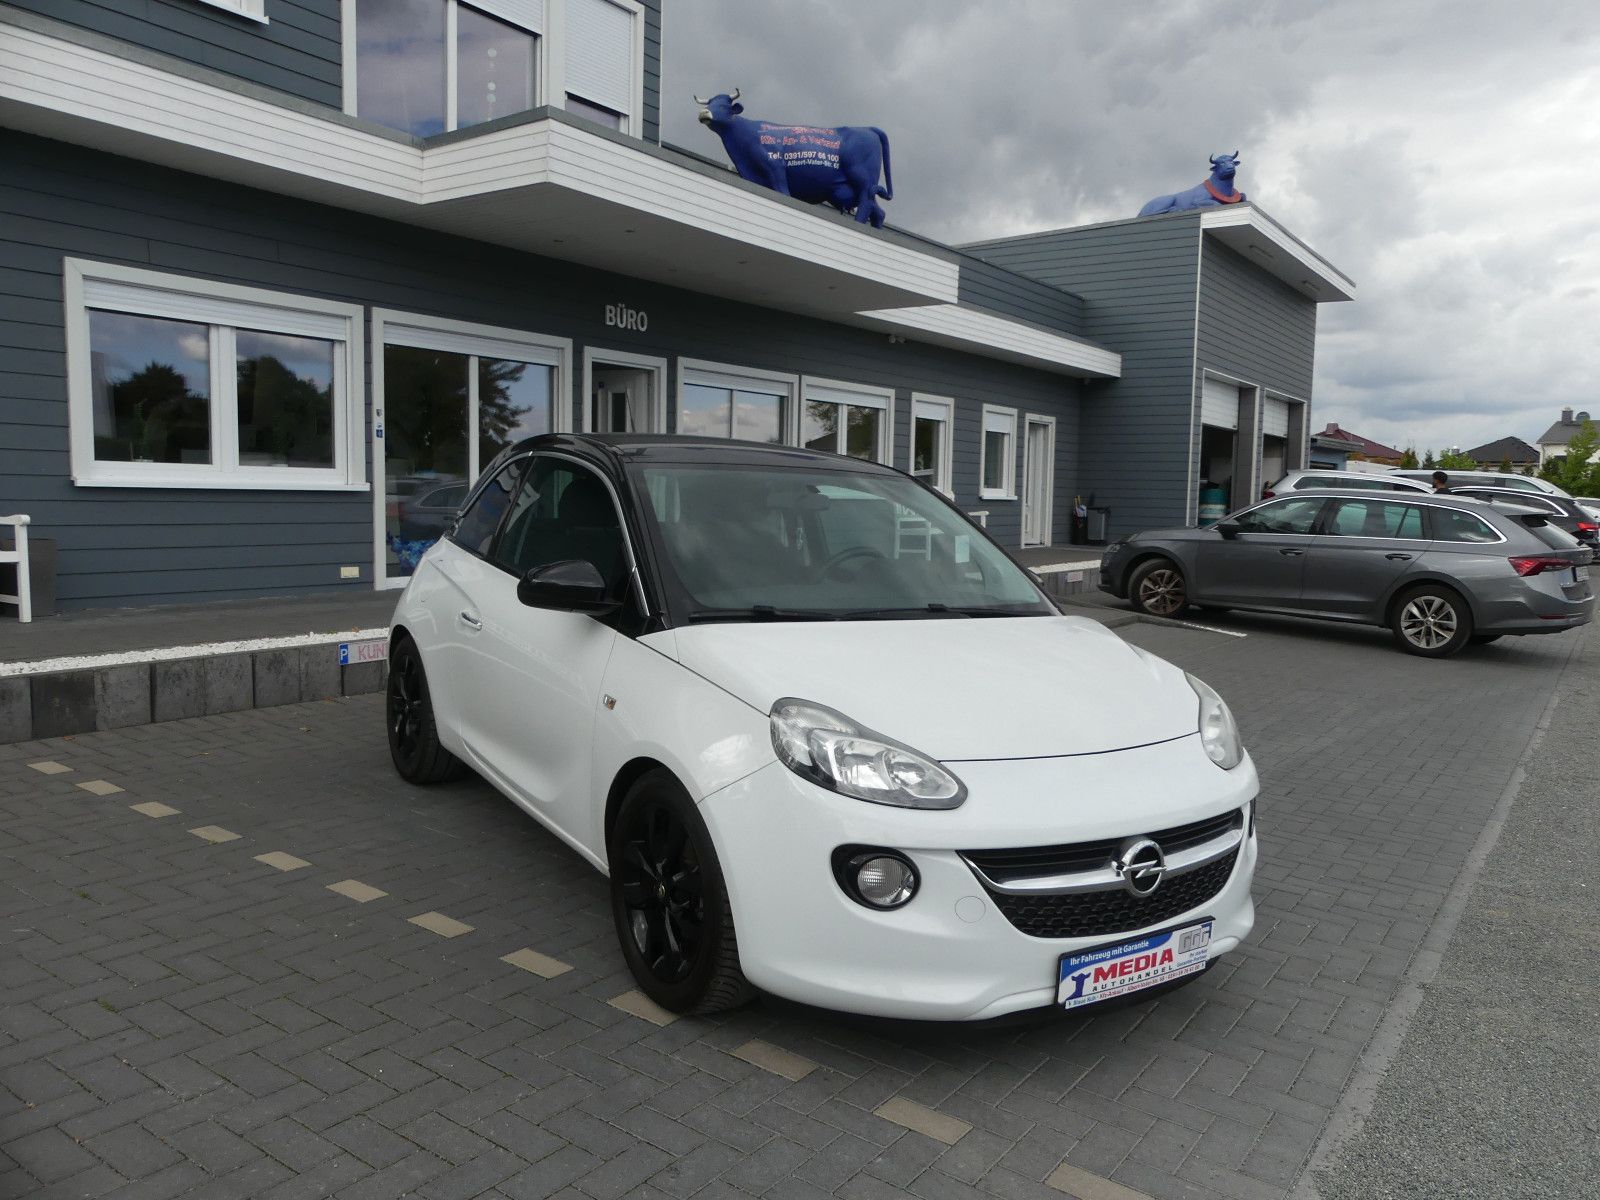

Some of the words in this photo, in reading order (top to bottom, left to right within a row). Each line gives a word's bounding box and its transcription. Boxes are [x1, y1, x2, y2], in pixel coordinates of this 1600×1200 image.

[768, 152, 782, 160] Tel.
[784, 151, 817, 160] 0391/597
[828, 154, 839, 162] 100
[605, 303, 648, 332] BÜRO
[340, 648, 348, 661] P
[1070, 957, 1080, 966] Ihr
[1081, 950, 1111, 964] Fahrzeug
[1111, 946, 1123, 956] mit
[1123, 940, 1149, 953] Garantie
[1093, 948, 1174, 984] MEDIA
[1092, 965, 1173, 992] AUTOHANDEL
